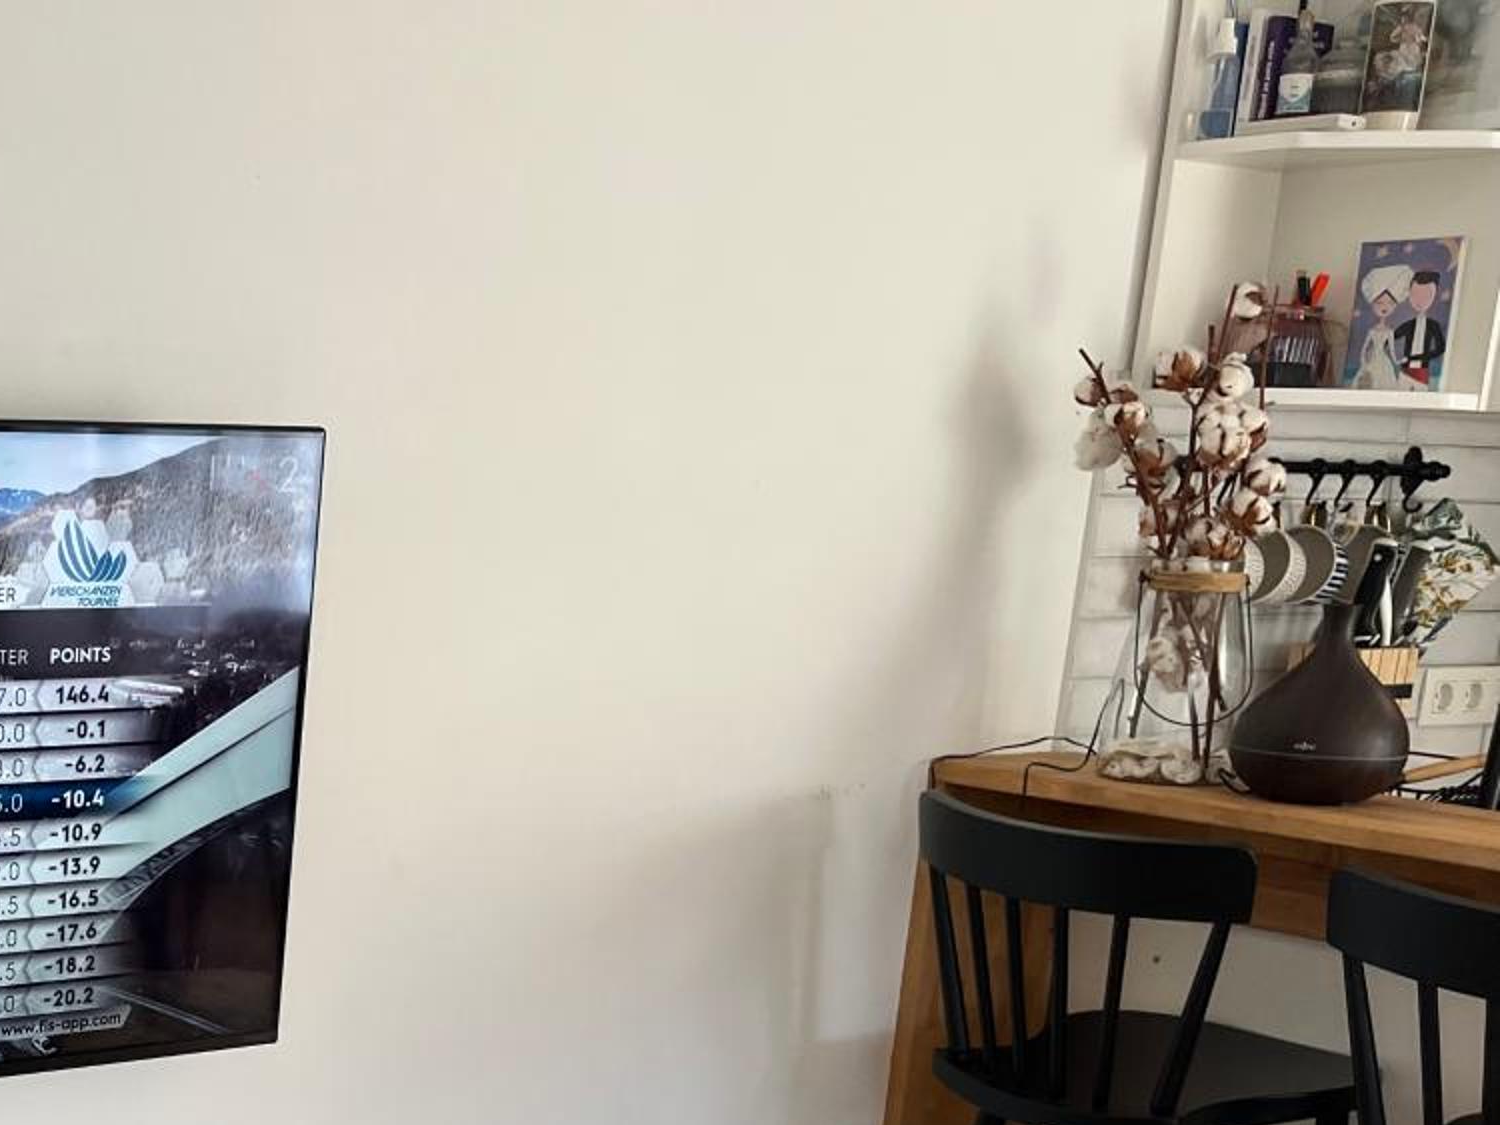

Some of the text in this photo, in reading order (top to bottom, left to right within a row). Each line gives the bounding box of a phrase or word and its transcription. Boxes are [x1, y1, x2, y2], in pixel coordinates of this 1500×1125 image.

[50, 647, 111, 664] POINTS
[55, 685, 110, 704] 146.4
[66, 720, 106, 739] -0.1
[65, 755, 105, 774] -6.2
[51, 789, 105, 808] -10.4
[50, 823, 102, 843] -10.9
[48, 856, 101, 876] -13.9
[47, 890, 100, 910] -16.5
[46, 922, 98, 943] -17.6
[44, 955, 95, 975] -18.2
[43, 987, 94, 1007] -20.2
[1, 1012, 122, 1036] www.fis-app.com
